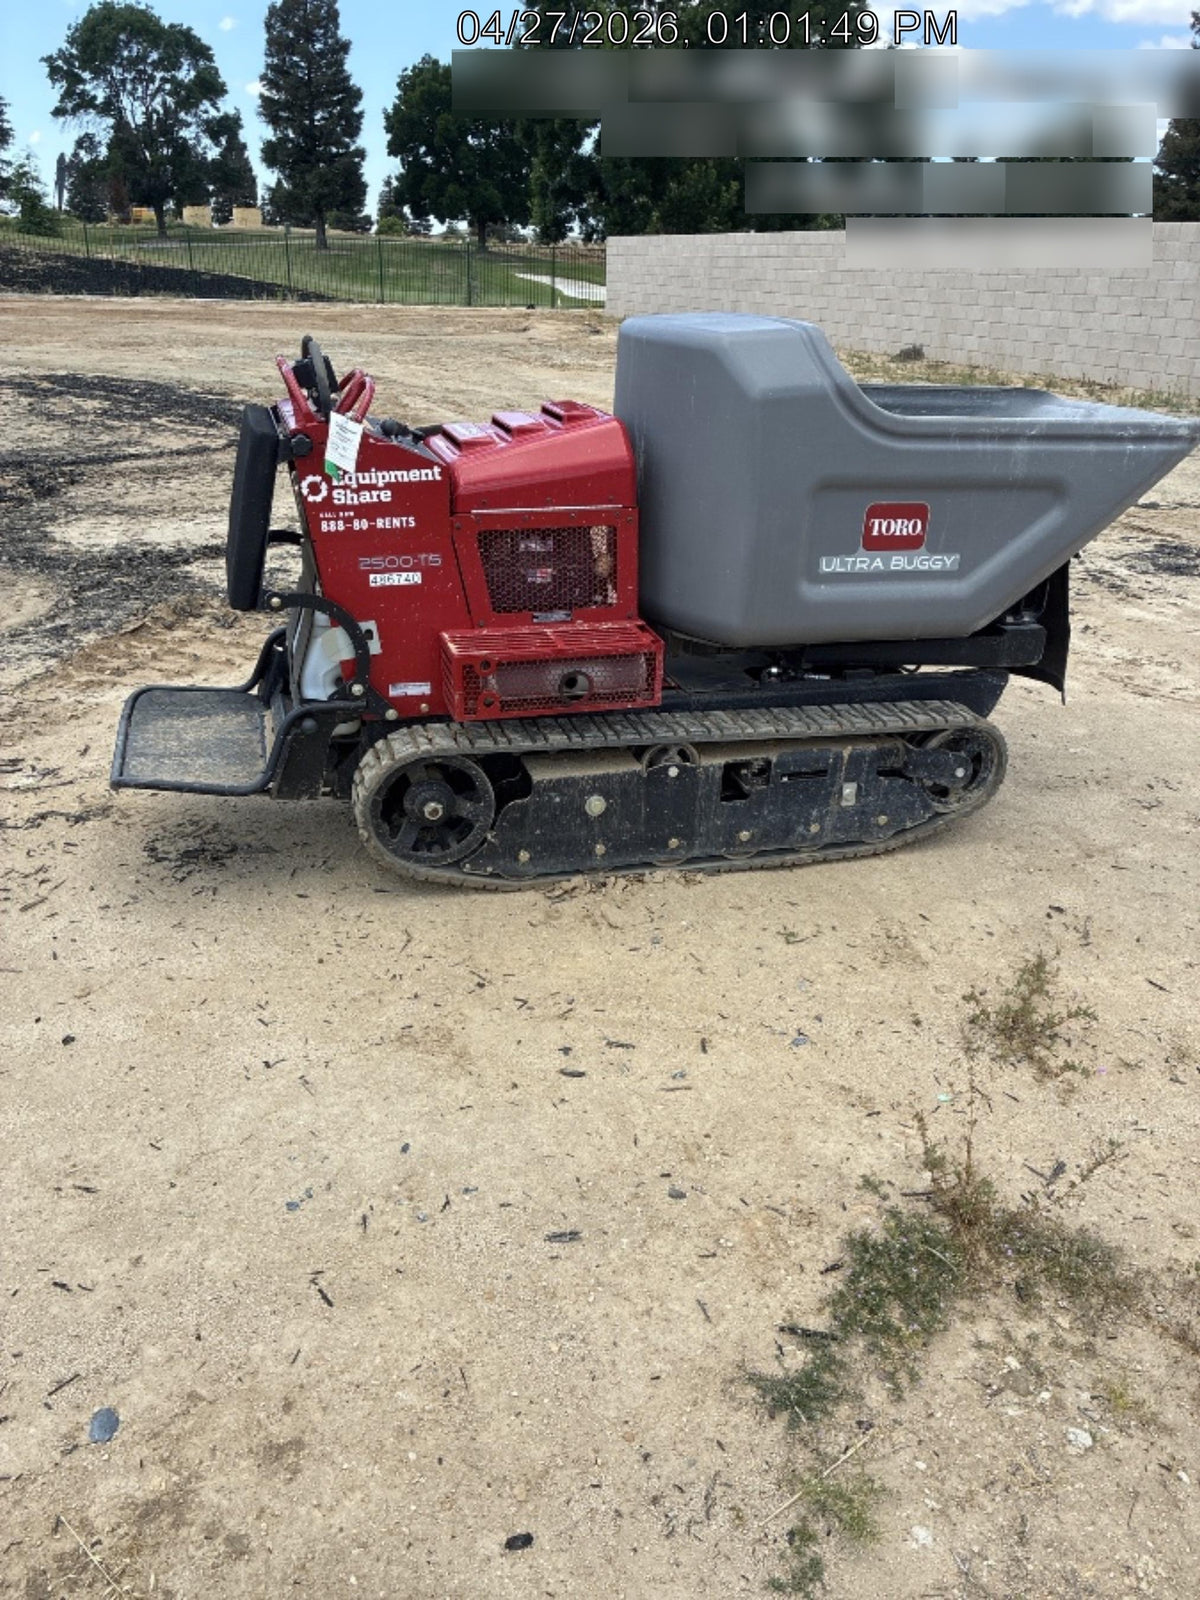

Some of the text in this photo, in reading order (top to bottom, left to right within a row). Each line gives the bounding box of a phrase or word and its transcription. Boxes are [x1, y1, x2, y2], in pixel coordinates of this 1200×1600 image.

[332, 488, 392, 505] Share
[321, 517, 415, 532] 888-80-RENTS
[869, 518, 922, 536] TORO
[822, 555, 956, 572] ULTRA BUGGY
[371, 573, 420, 584] 486740
